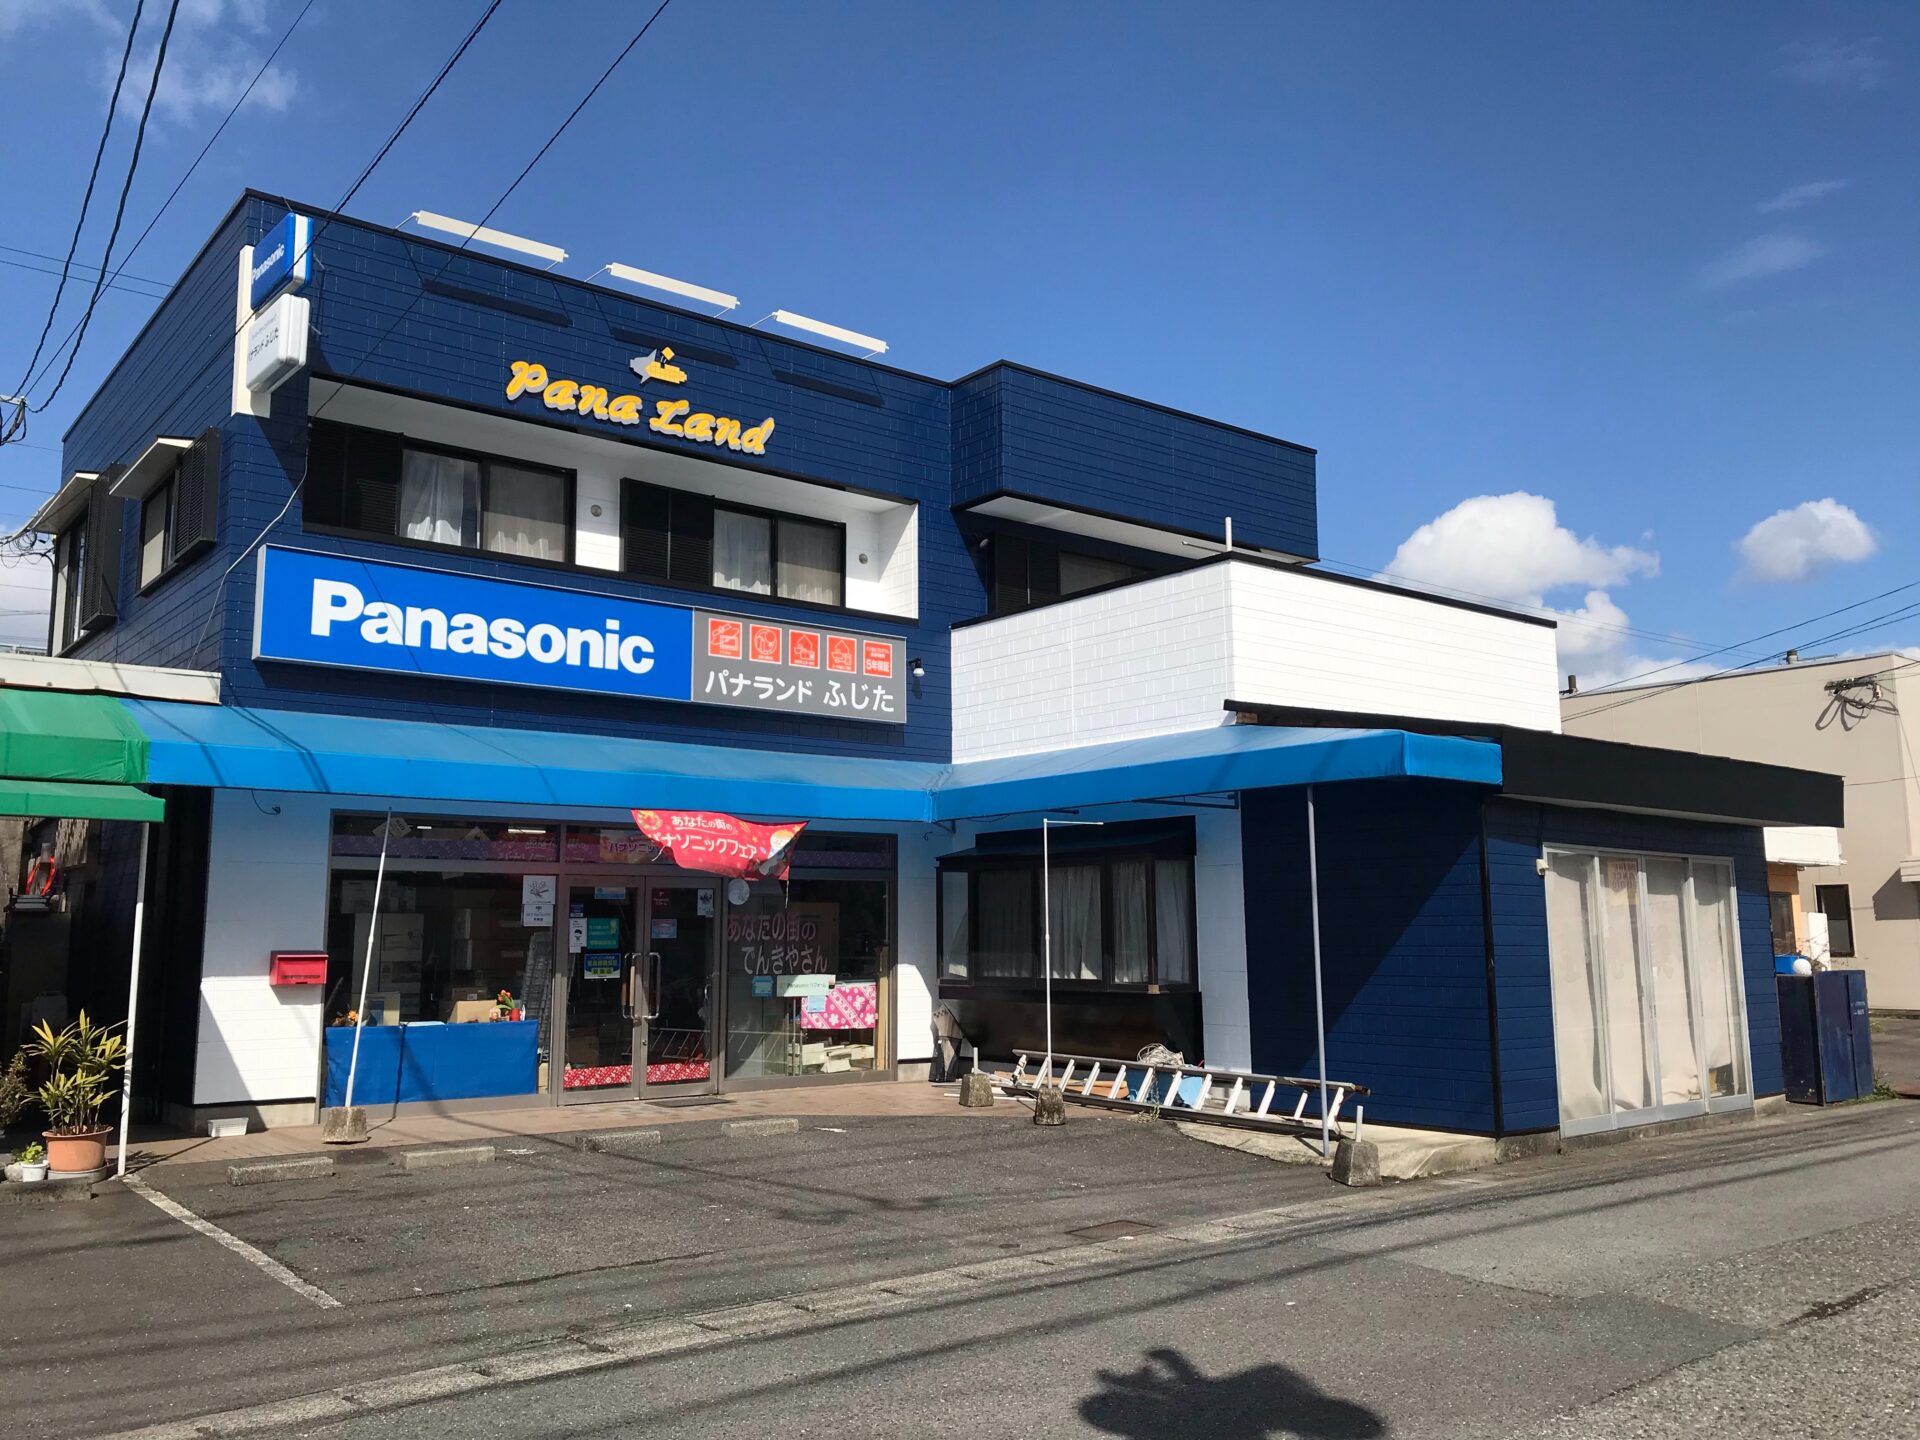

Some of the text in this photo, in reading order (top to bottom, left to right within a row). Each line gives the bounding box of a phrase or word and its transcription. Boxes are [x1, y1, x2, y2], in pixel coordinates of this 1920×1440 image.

[251, 243, 285, 285] Panasonic
[506, 360, 775, 455] Pana Land
[310, 578, 655, 675] Panasonic
[705, 669, 895, 713] パナランド ふじた
[671, 815, 733, 831] あなたの街の
